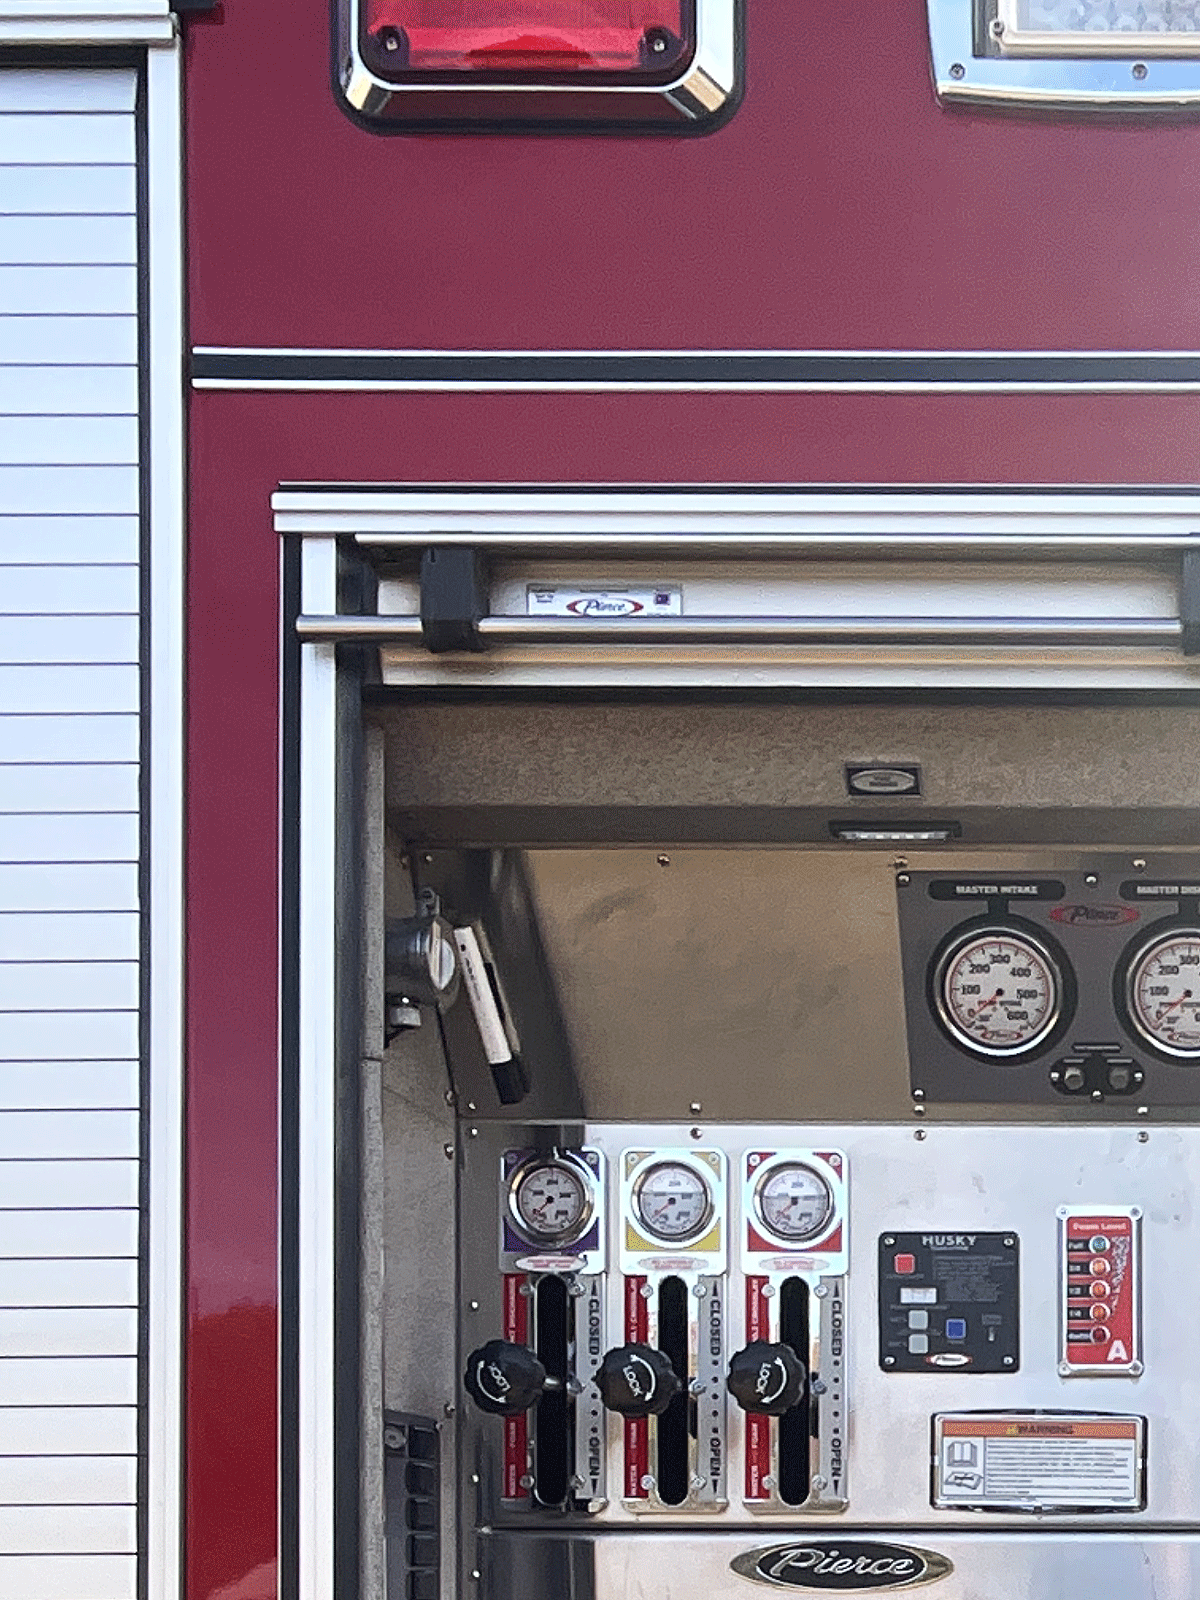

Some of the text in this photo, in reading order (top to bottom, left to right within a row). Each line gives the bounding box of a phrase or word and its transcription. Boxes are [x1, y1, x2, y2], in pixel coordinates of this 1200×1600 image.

[956, 885, 999, 894] MASTER
[1137, 885, 1179, 894] MASTER
[990, 954, 1011, 964] 300
[1179, 955, 1200, 965] 300
[969, 964, 991, 974] 200
[1010, 968, 1031, 977] 400
[1158, 965, 1179, 975] 200
[962, 985, 981, 995] 100
[1017, 989, 1038, 999] 500
[1150, 986, 1169, 996] 100
[1007, 1011, 1029, 1020] 600
[922, 1235, 977, 1246] HUSKY
[589, 1298, 600, 1356] CLOSED
[710, 1300, 721, 1356] CLOSED
[832, 1300, 842, 1356] CLOSED
[1107, 1340, 1128, 1361] A
[488, 1362, 512, 1392] LOCK
[622, 1365, 645, 1397] LOCK
[755, 1362, 772, 1395] LOCK
[1018, 1425, 1074, 1434] WARNING
[589, 1436, 600, 1476] OPEN
[710, 1437, 721, 1476] OPEN
[831, 1438, 842, 1477] OPEN
[769, 1547, 915, 1576] Pierce
